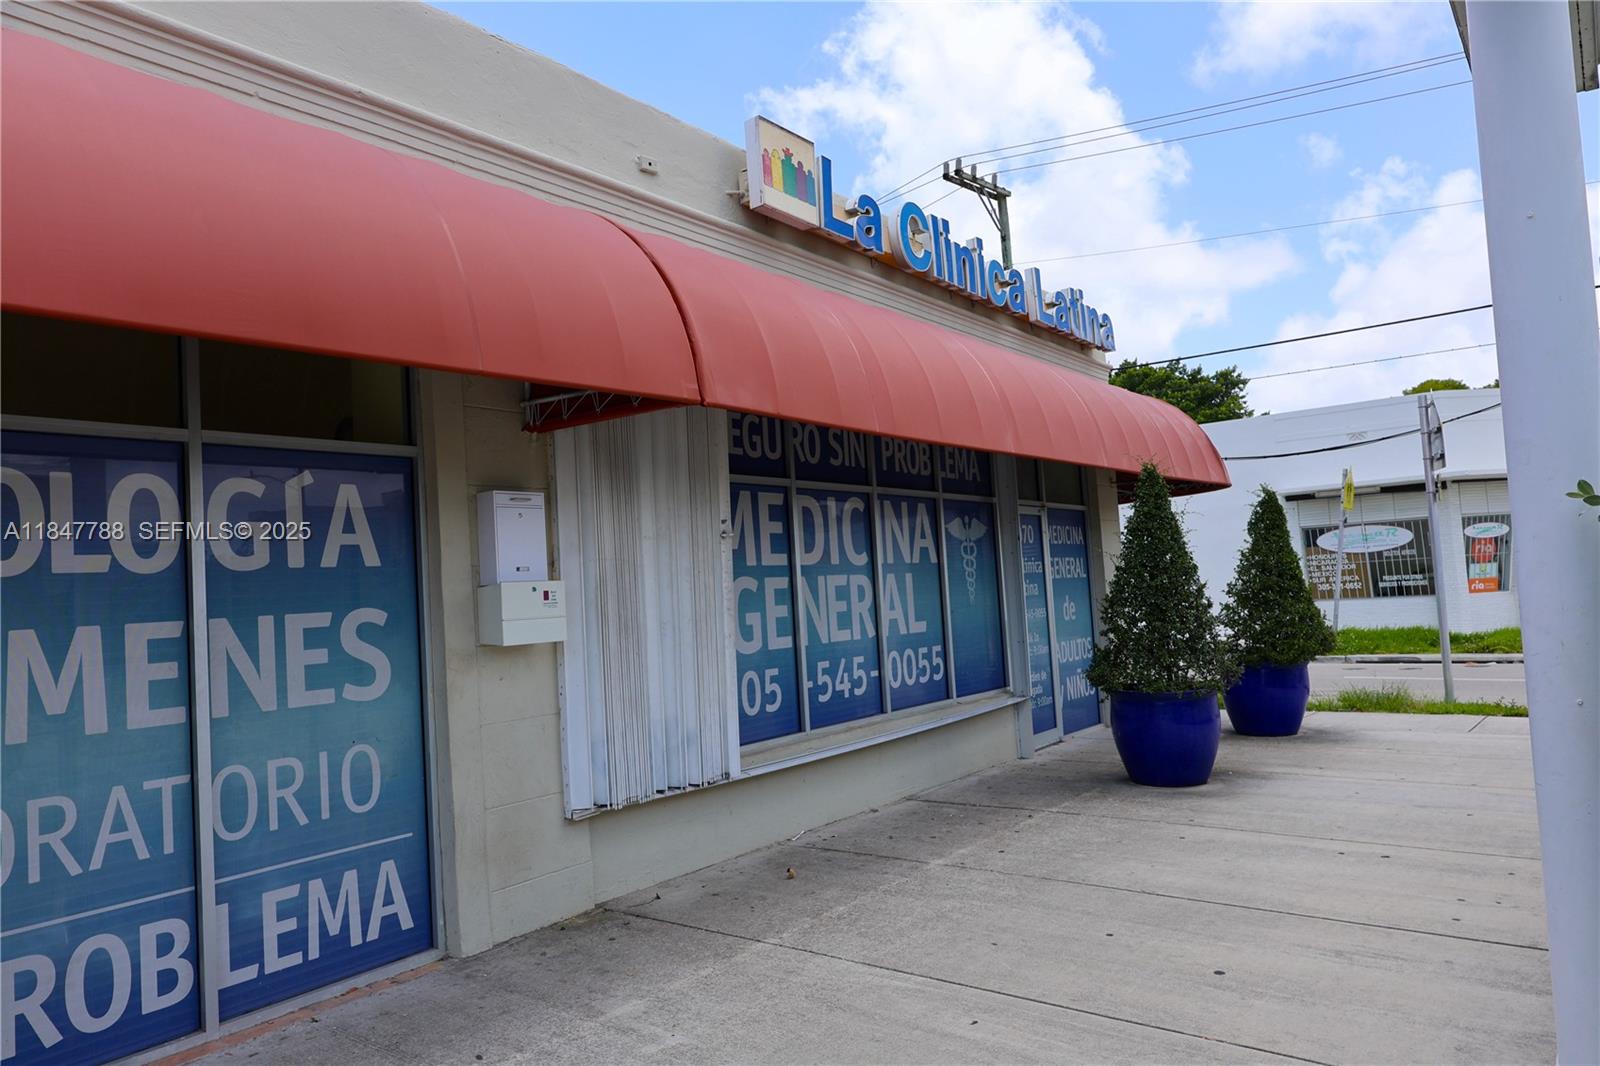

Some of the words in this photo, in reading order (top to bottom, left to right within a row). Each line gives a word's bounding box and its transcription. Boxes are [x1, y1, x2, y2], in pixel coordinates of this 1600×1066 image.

[817, 154, 885, 254] La
[898, 200, 1027, 314] Clinica
[1026, 266, 1116, 352] Latina
[828, 427, 867, 469] SIN
[881, 436, 982, 482] PROBLEMA
[1321, 563, 1357, 571] SALVDOR
[1476, 540, 1492, 553] ria
[1063, 594, 1077, 621] de
[1471, 579, 1485, 590] ria
[733, 572, 927, 655] GENERAL
[4, 607, 393, 747] MENES
[1056, 636, 1093, 664] ADULTOS
[0, 743, 382, 889] RATORIO
[0, 858, 415, 1063] ROBLEMA
